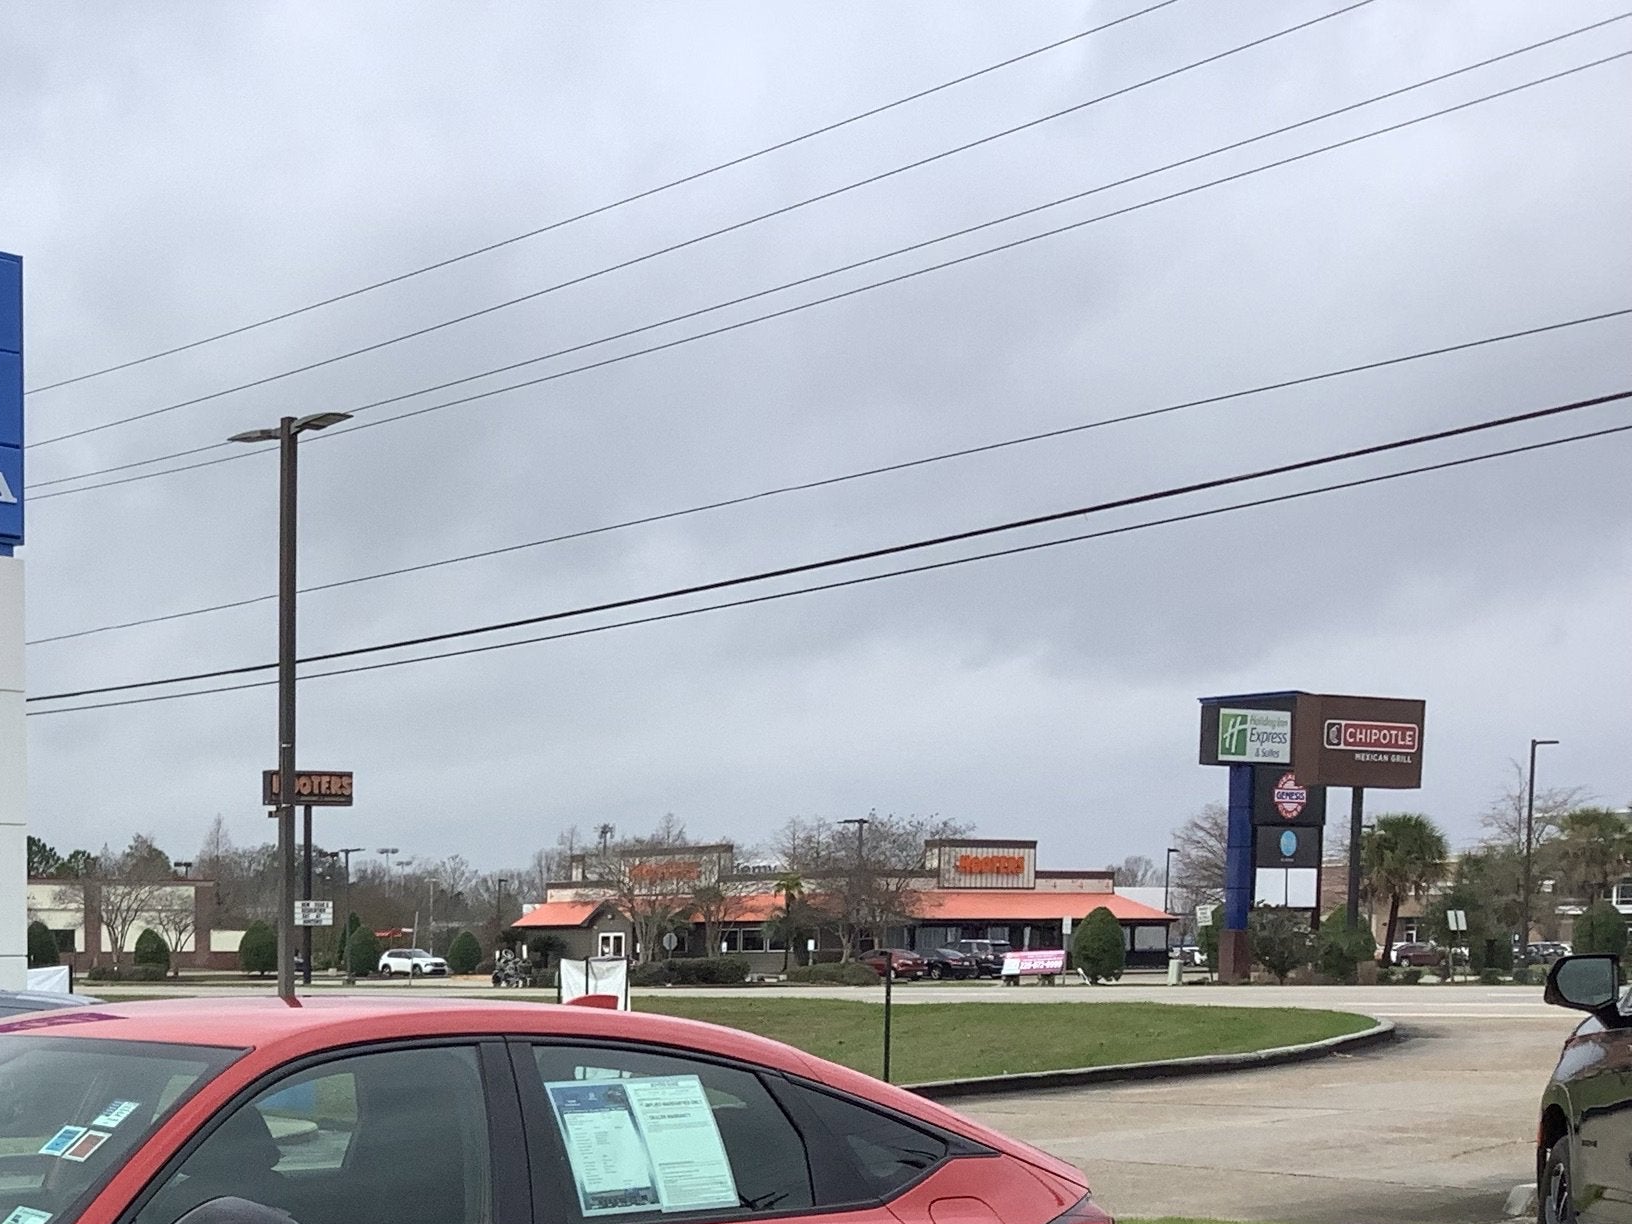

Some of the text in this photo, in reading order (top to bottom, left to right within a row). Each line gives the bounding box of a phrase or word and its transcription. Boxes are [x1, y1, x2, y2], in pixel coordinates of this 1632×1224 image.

[1249, 727, 1288, 746] Express
[1346, 728, 1414, 745] CHIPOTLE
[1355, 752, 1412, 763] MEXICAN GRILL
[1276, 791, 1305, 801] GENESIS
